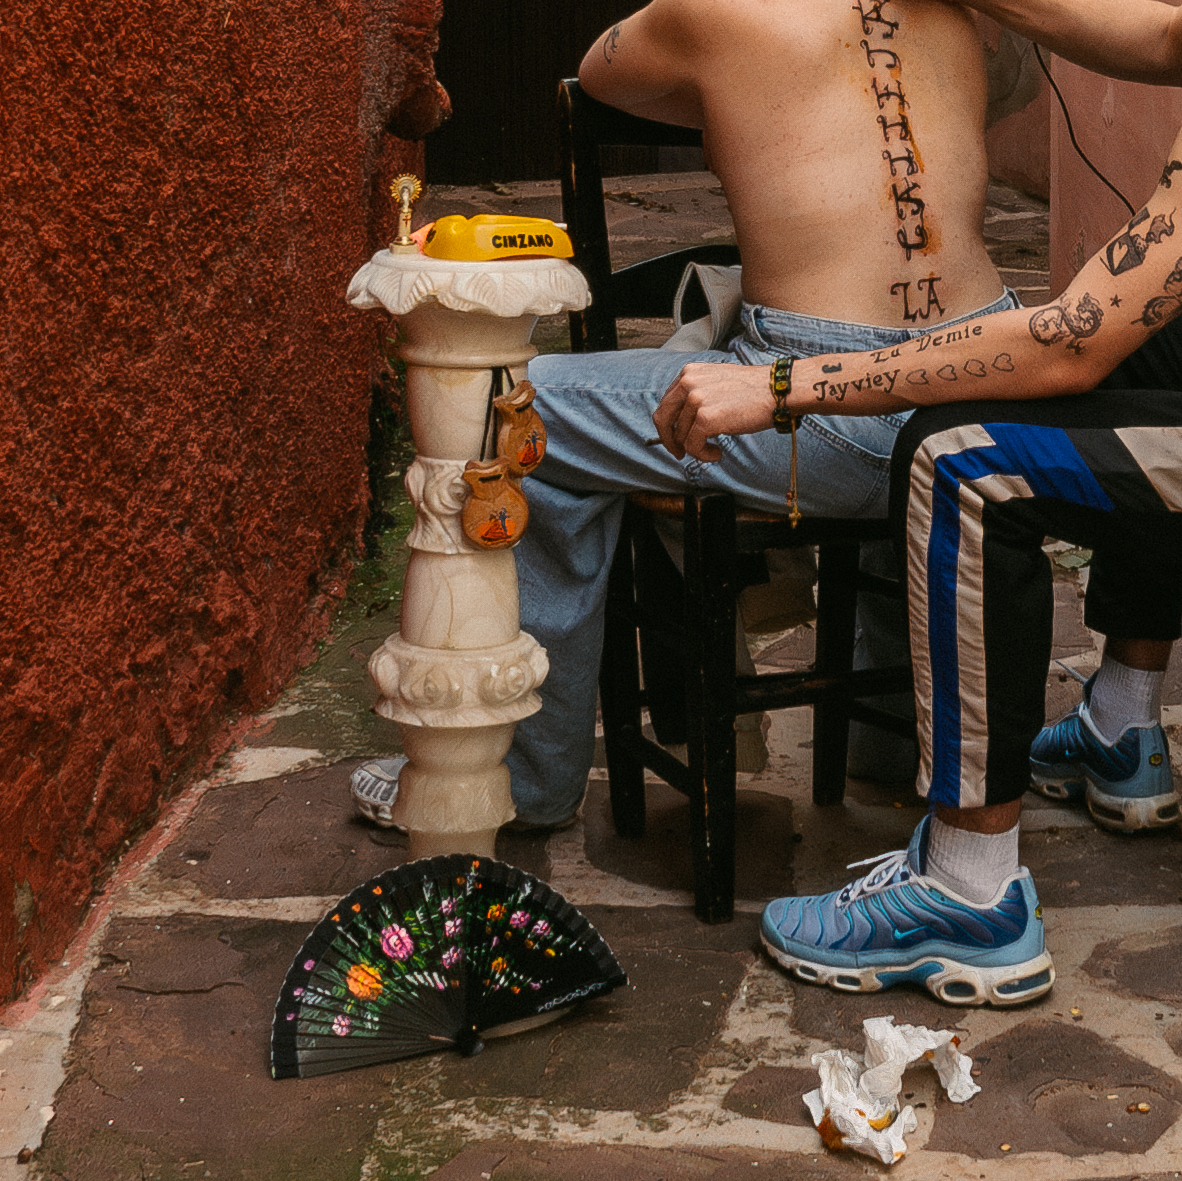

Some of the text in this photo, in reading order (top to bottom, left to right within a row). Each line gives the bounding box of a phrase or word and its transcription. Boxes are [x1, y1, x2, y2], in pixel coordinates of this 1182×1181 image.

[492, 234, 553, 249] CINZANO
[890, 276, 946, 323] LA
[870, 325, 983, 364] Lu Demie
[813, 369, 900, 402] Jayviey
